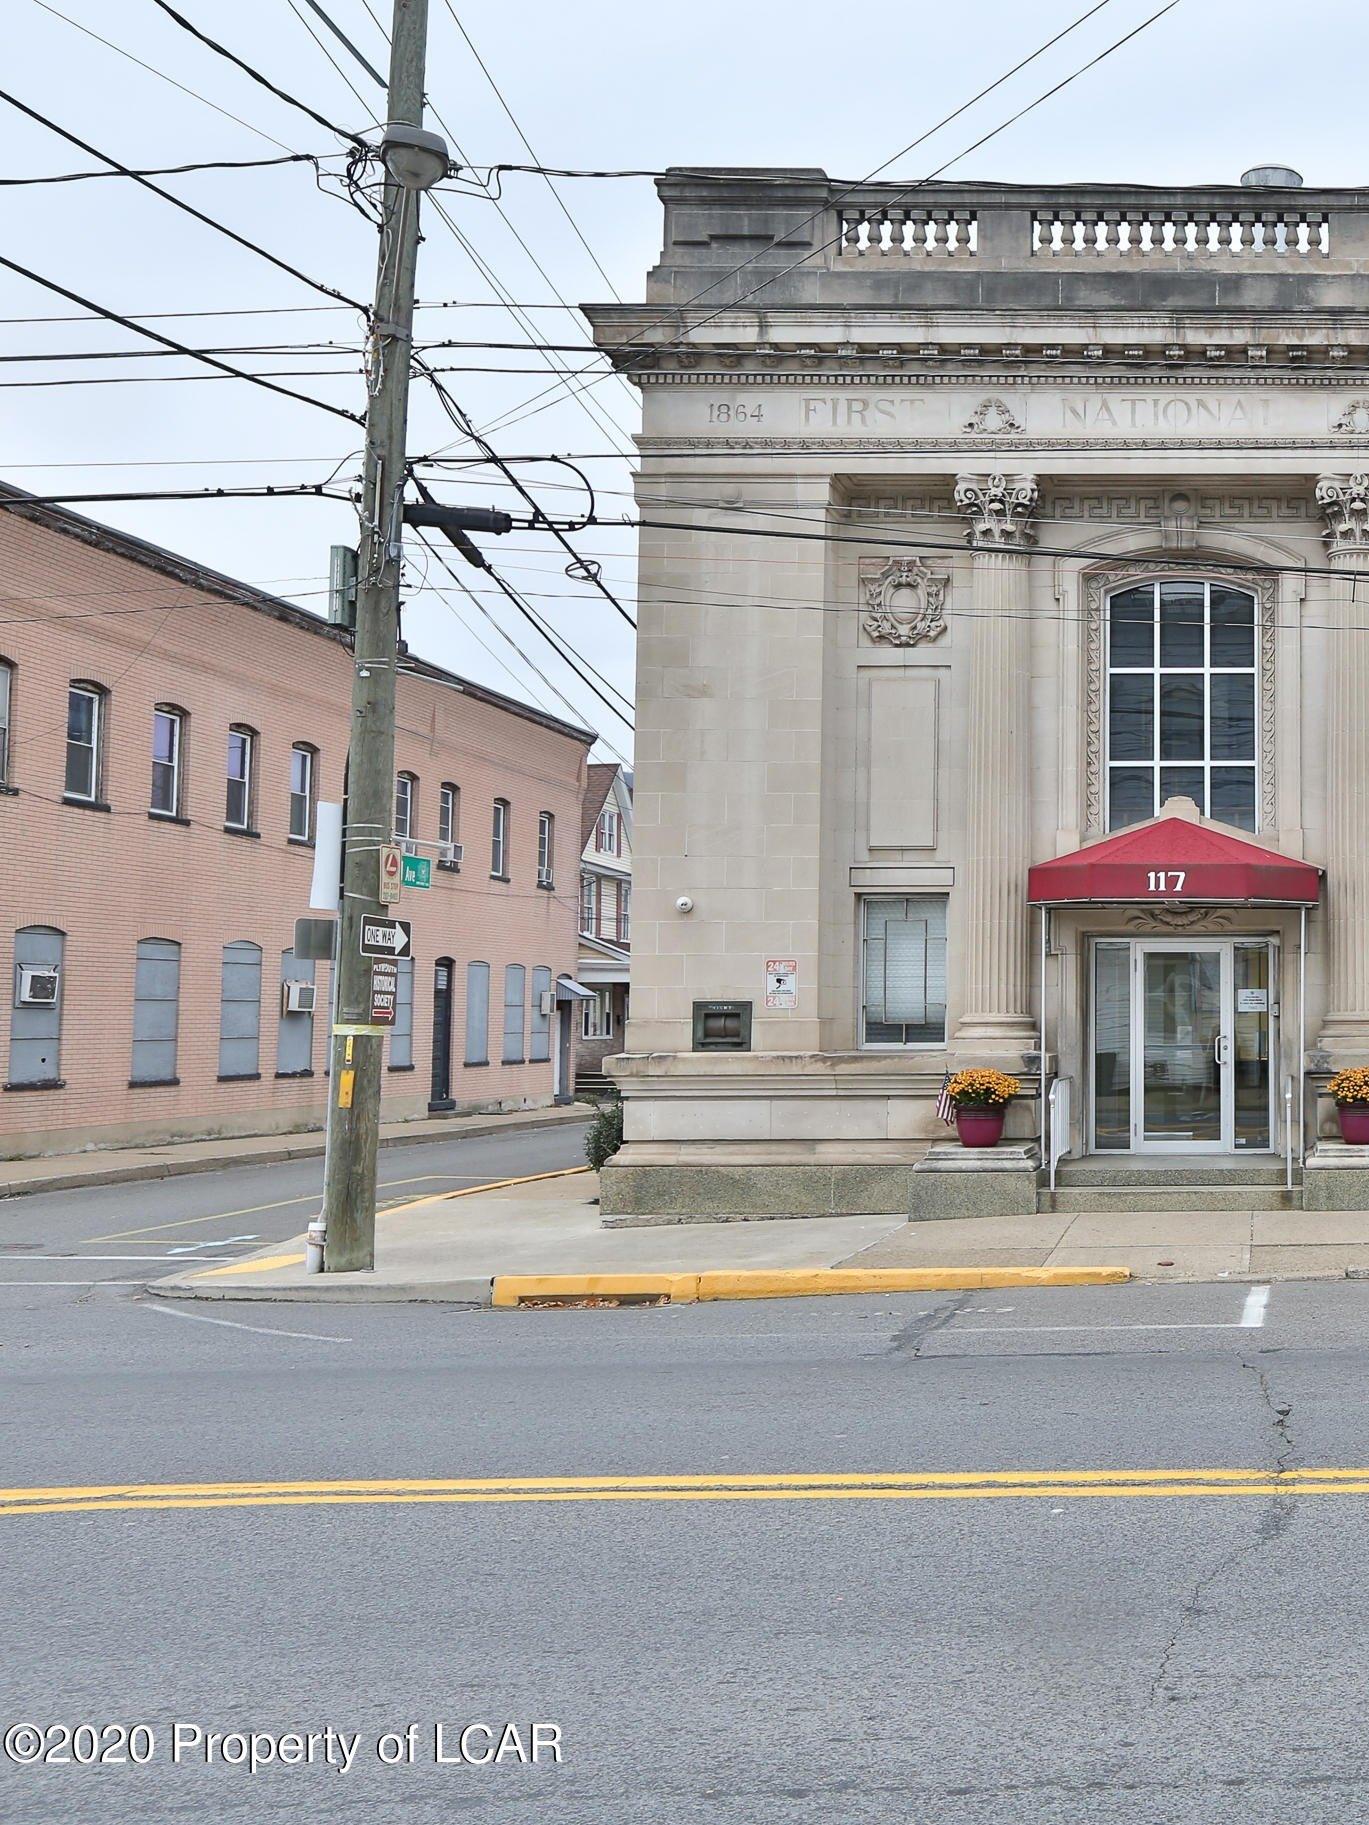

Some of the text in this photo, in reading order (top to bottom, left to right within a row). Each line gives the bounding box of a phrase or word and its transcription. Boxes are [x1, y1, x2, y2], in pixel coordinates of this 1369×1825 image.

[708, 403, 763, 423] 1864
[802, 397, 926, 427] FIRST
[404, 866, 416, 882] Ave
[1147, 871, 1186, 891] 117
[366, 927, 396, 945] ONE WAY
[373, 963, 397, 973] PLYMOUTH
[768, 961, 780, 971] 24
[373, 975, 396, 992] HISTORICAL
[374, 993, 394, 1007] SOCIETY
